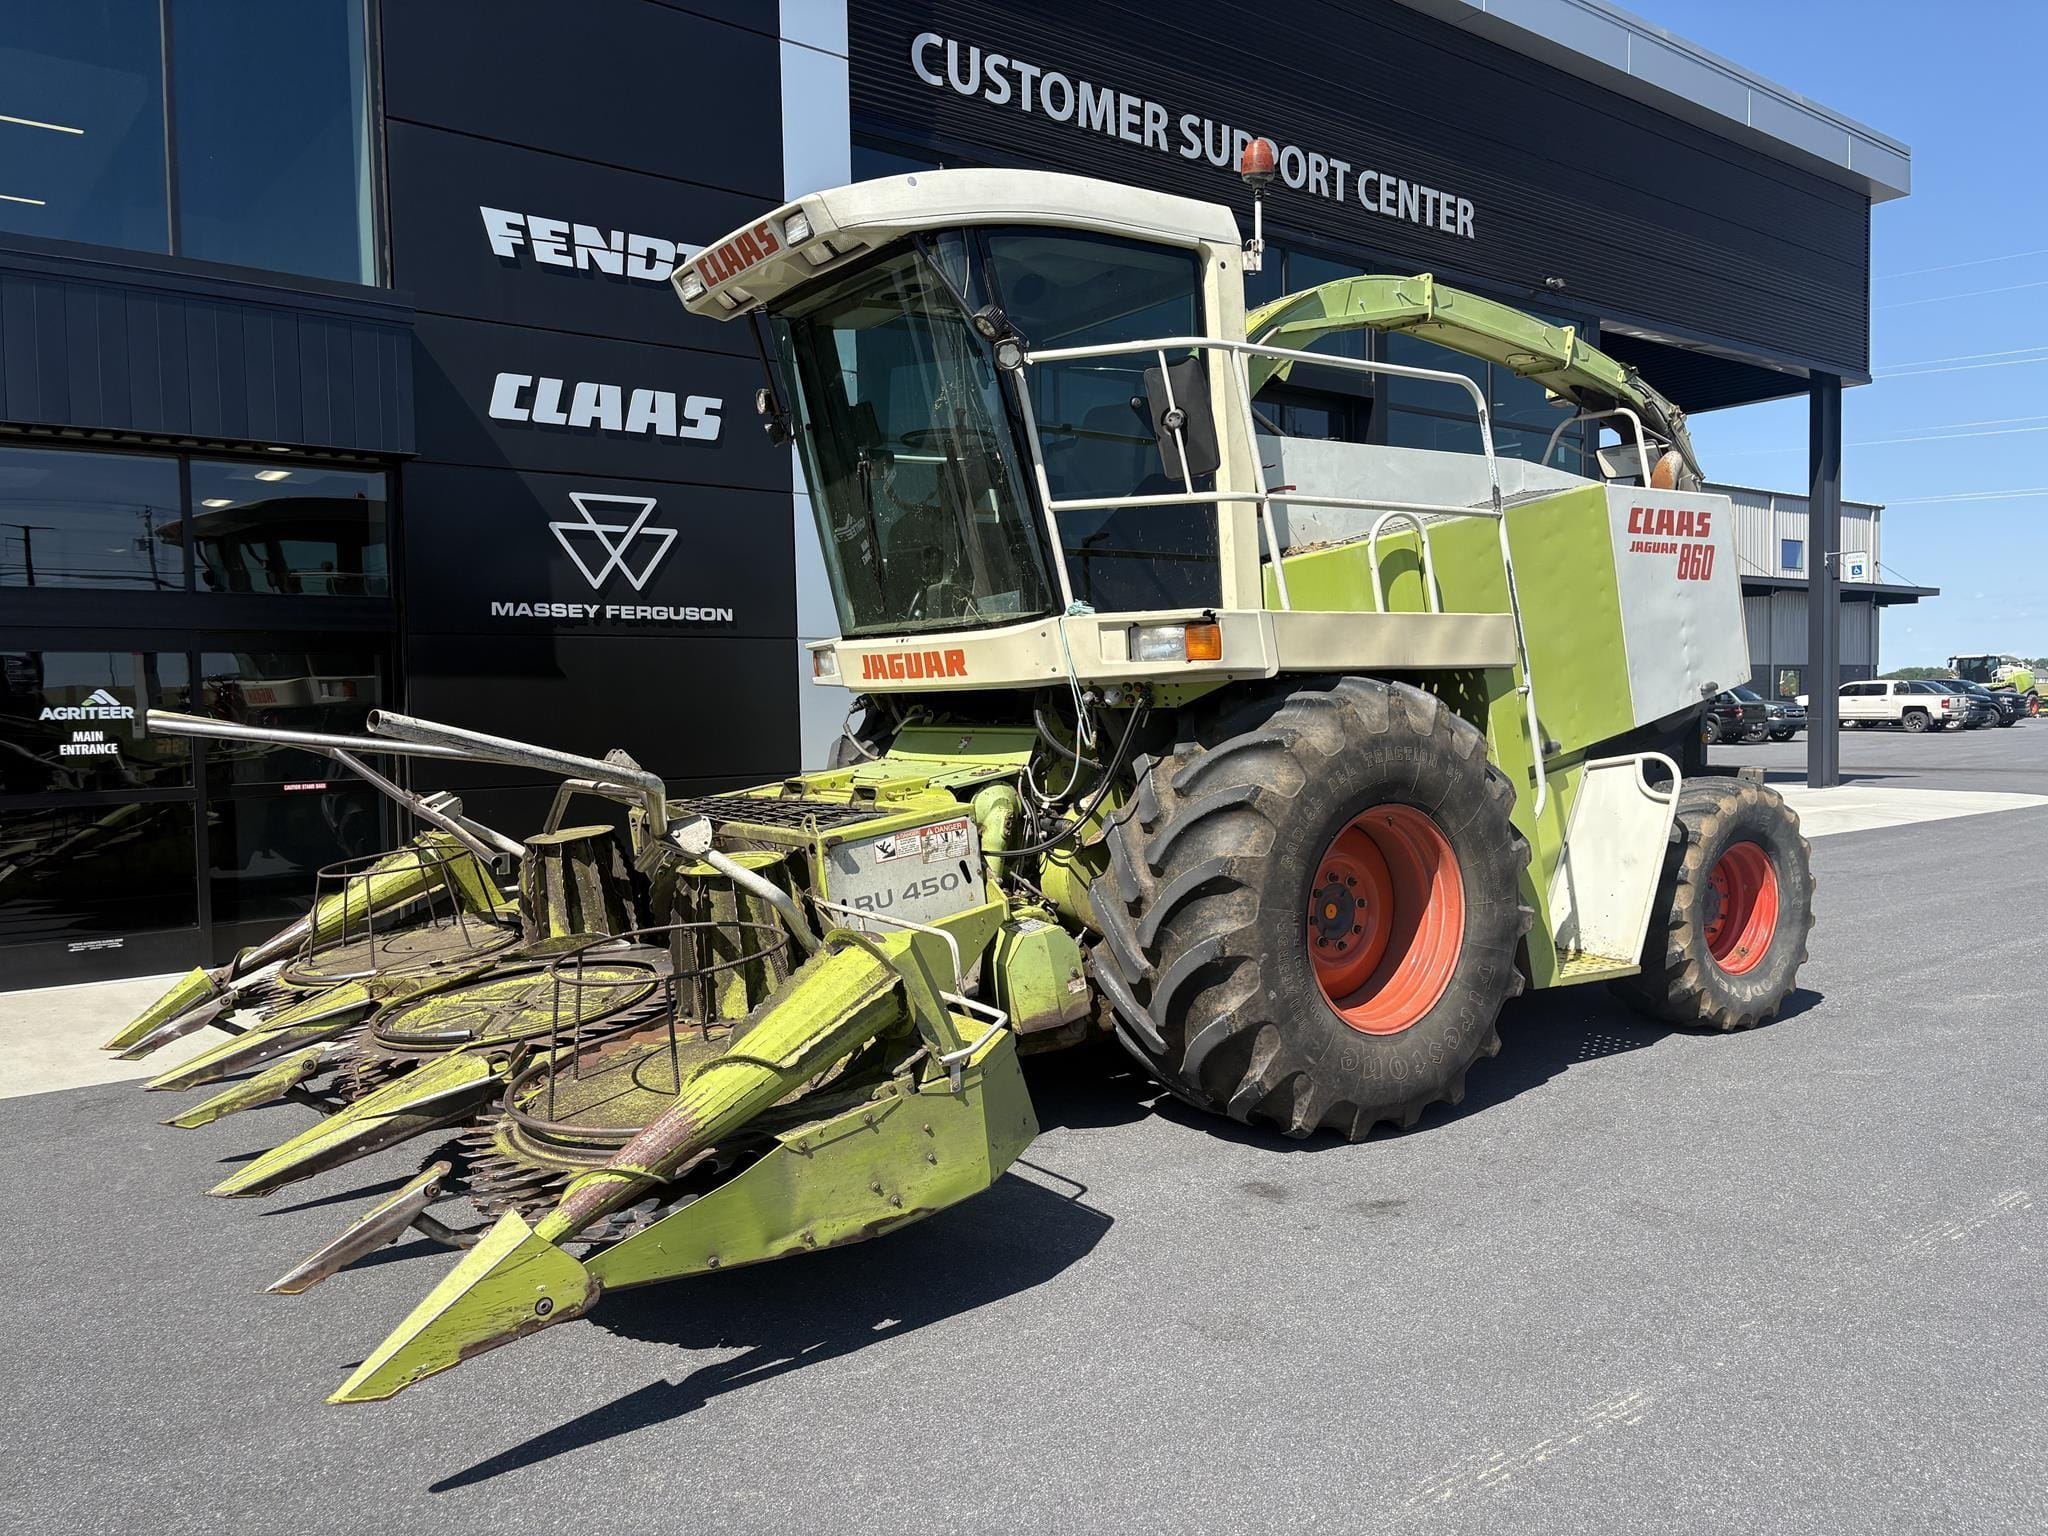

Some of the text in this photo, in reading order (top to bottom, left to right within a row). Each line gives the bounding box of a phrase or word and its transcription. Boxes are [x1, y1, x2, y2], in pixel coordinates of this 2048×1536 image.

[911, 32, 1169, 152] CUSTOMER
[1358, 170, 1475, 239] CENTER
[696, 220, 779, 287] CLAAS
[488, 372, 723, 441] CLAAS
[1628, 507, 1711, 538] CLAAS
[1629, 541, 1678, 554] JAGUAR
[1677, 543, 1715, 580] 860
[491, 601, 733, 622] MASSEY FERGUSON
[862, 649, 968, 679] JAGUAR
[39, 706, 134, 720] AGRITEER
[60, 743, 118, 755] ENTRANCE
[73, 731, 104, 742] MAIN
[934, 822, 961, 834] DANGER
[855, 873, 959, 912] RU 450
